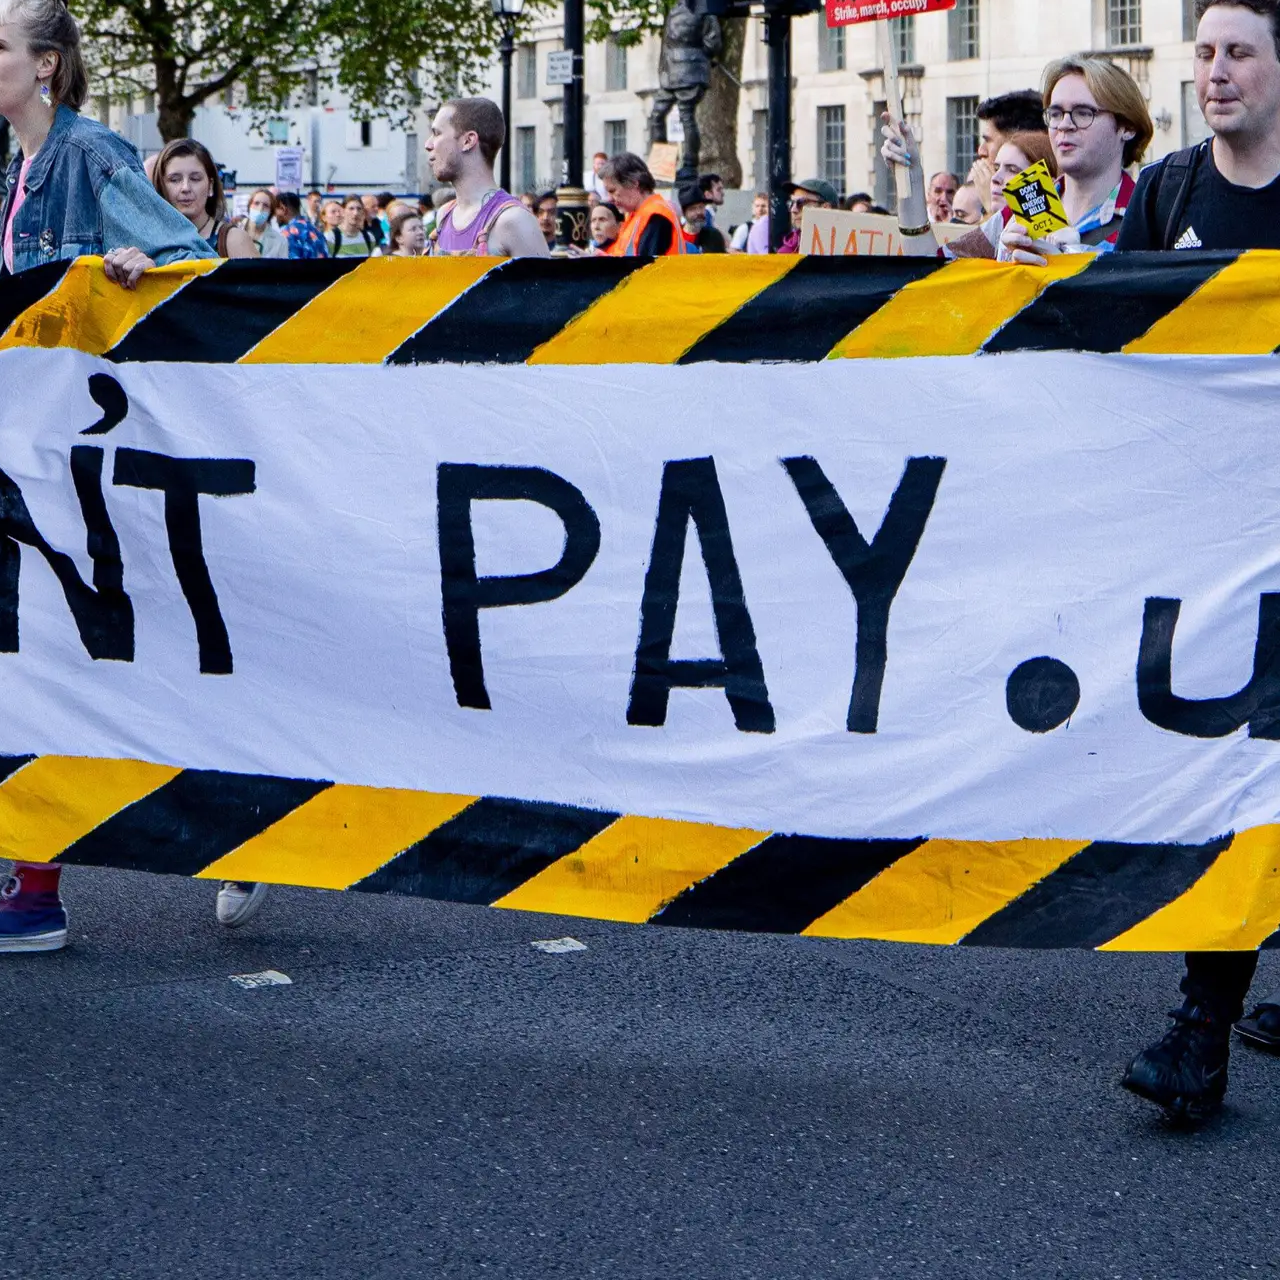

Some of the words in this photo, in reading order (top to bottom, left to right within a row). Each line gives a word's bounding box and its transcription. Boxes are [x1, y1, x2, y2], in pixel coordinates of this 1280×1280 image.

[834, 6, 859, 22] Strike,
[860, 0, 890, 18] march,
[1025, 191, 1038, 202] PAY
[1021, 194, 1046, 212] ENERGY
[1028, 204, 1047, 216] BILLS
[1033, 221, 1047, 231] OCT
[1048, 218, 1054, 226] 1
[1174, 240, 1202, 250] adidas
